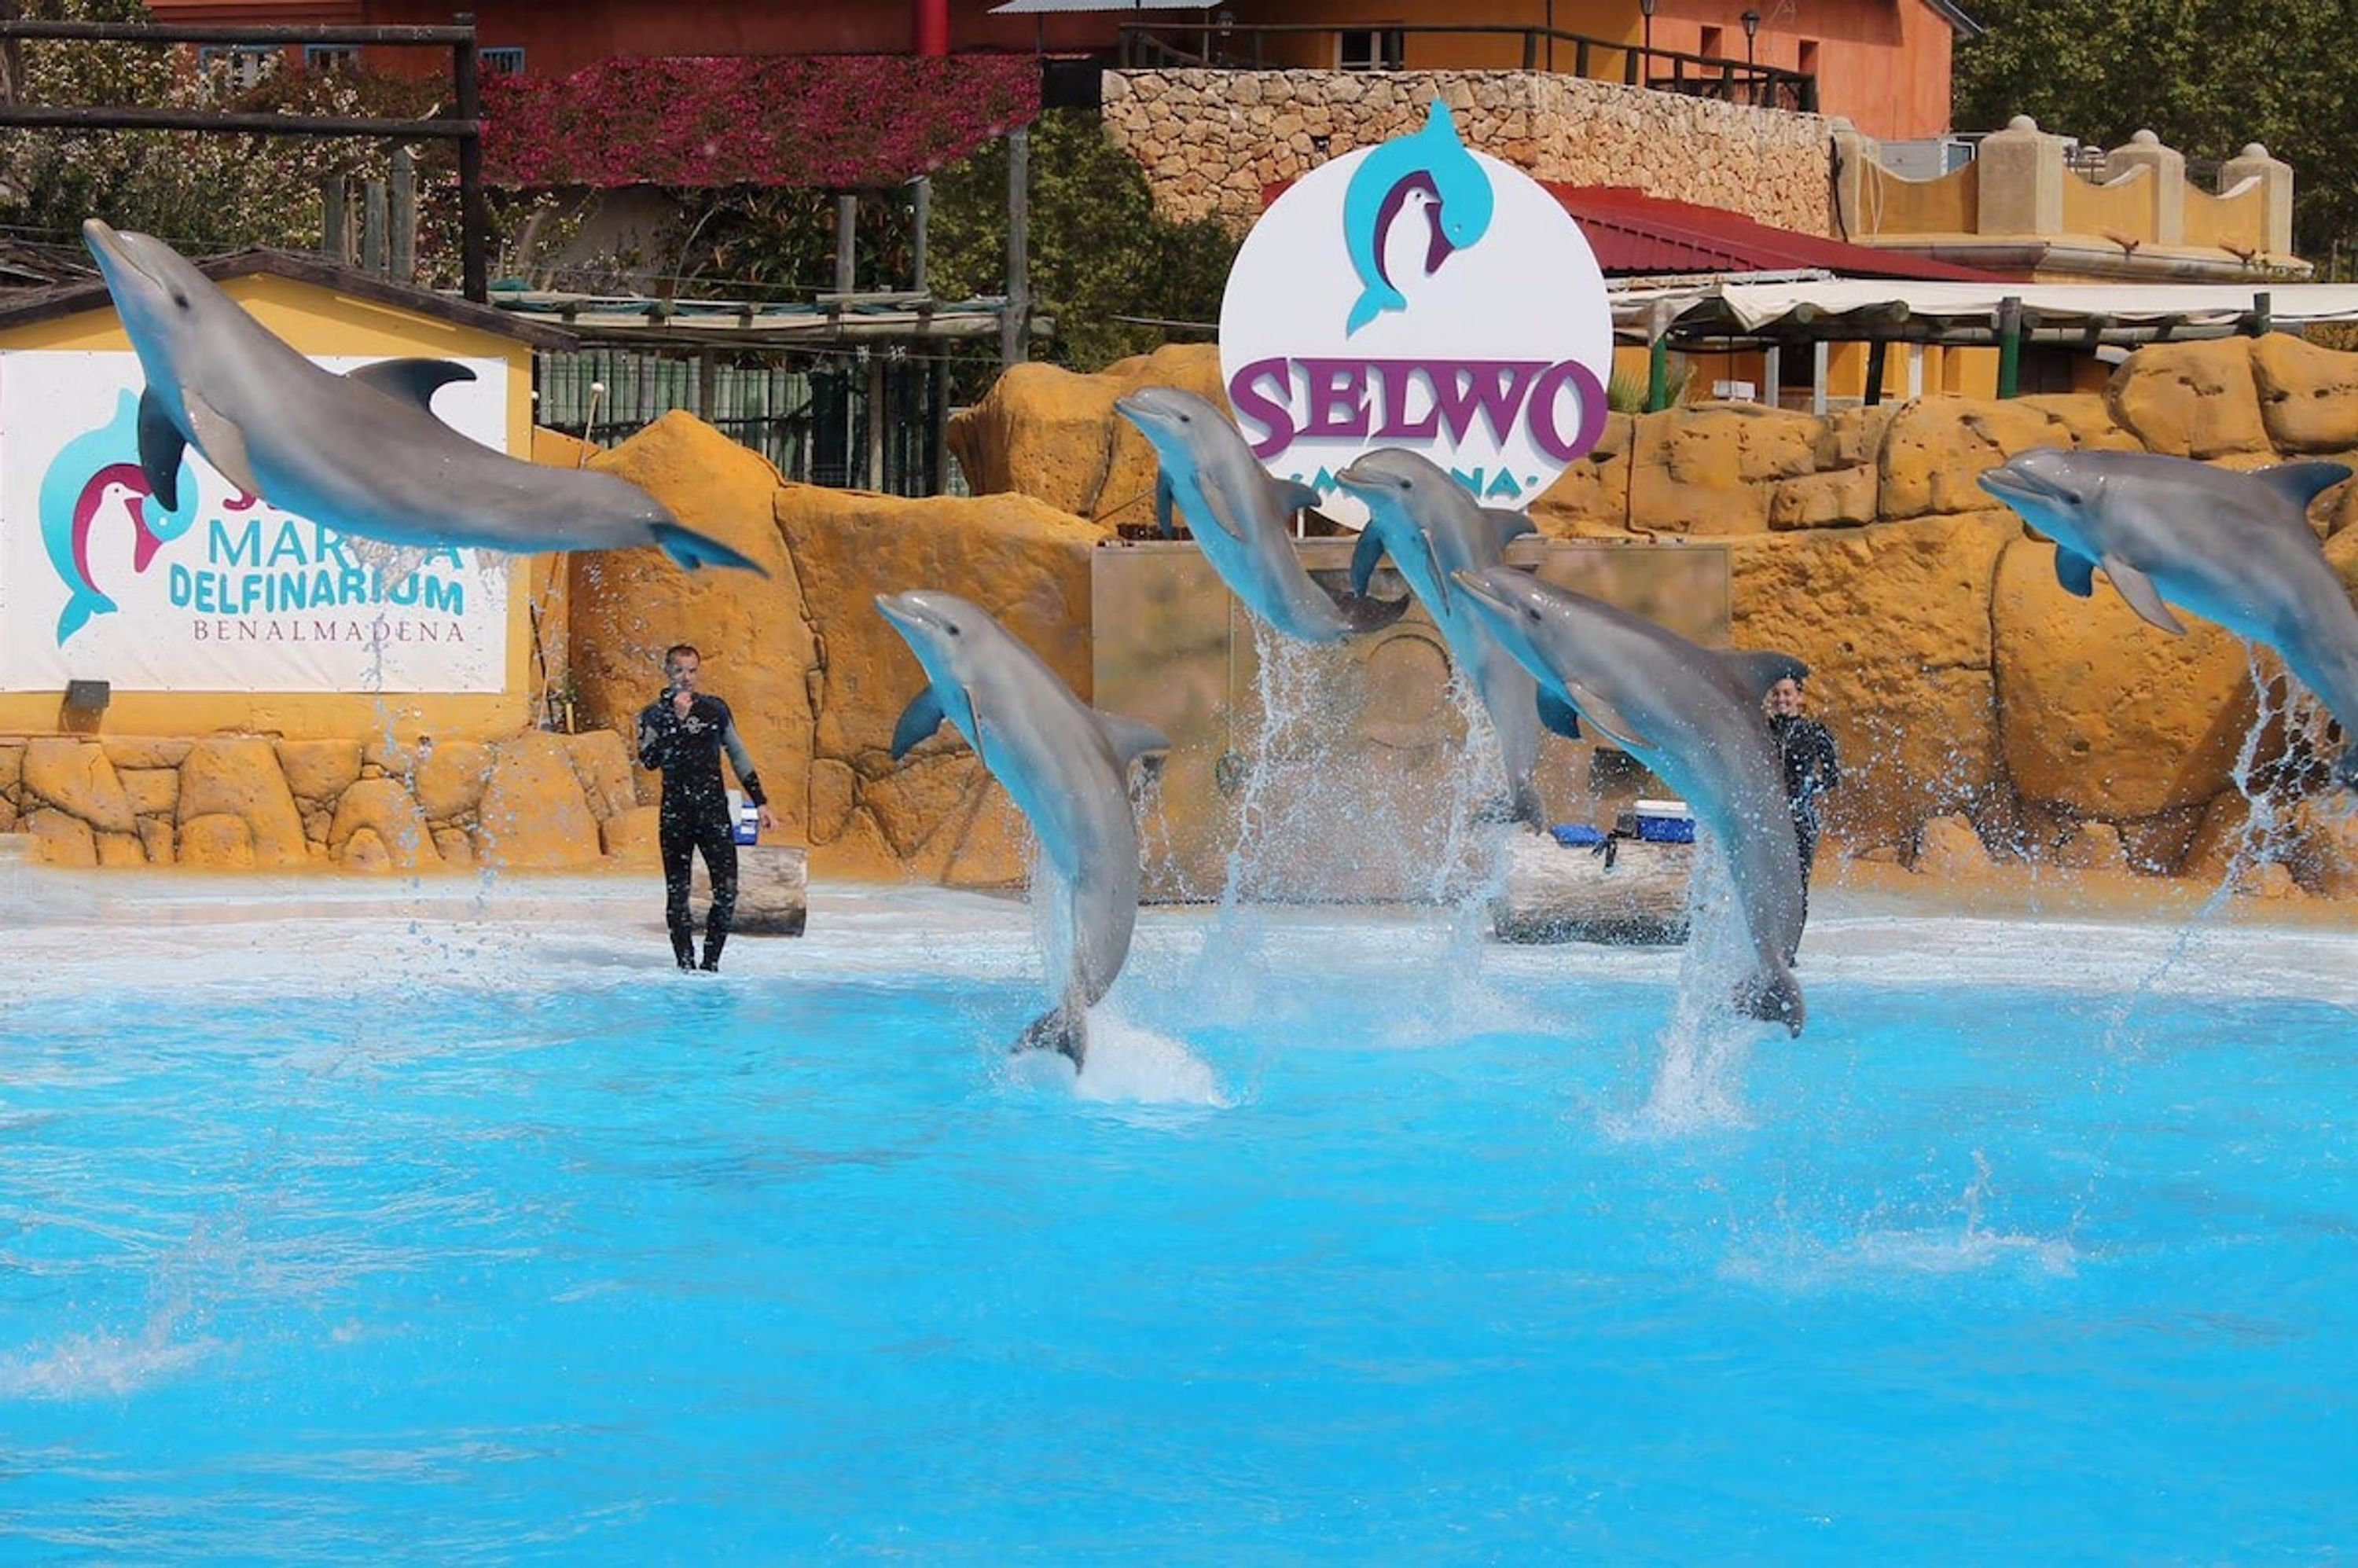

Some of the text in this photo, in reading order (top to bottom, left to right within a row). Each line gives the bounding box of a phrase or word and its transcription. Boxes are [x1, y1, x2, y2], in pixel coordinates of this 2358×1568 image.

[1229, 357, 1609, 462] SELWO
[171, 563, 464, 615] DELFINARIUM
[193, 618, 465, 641] BENALMADENA
